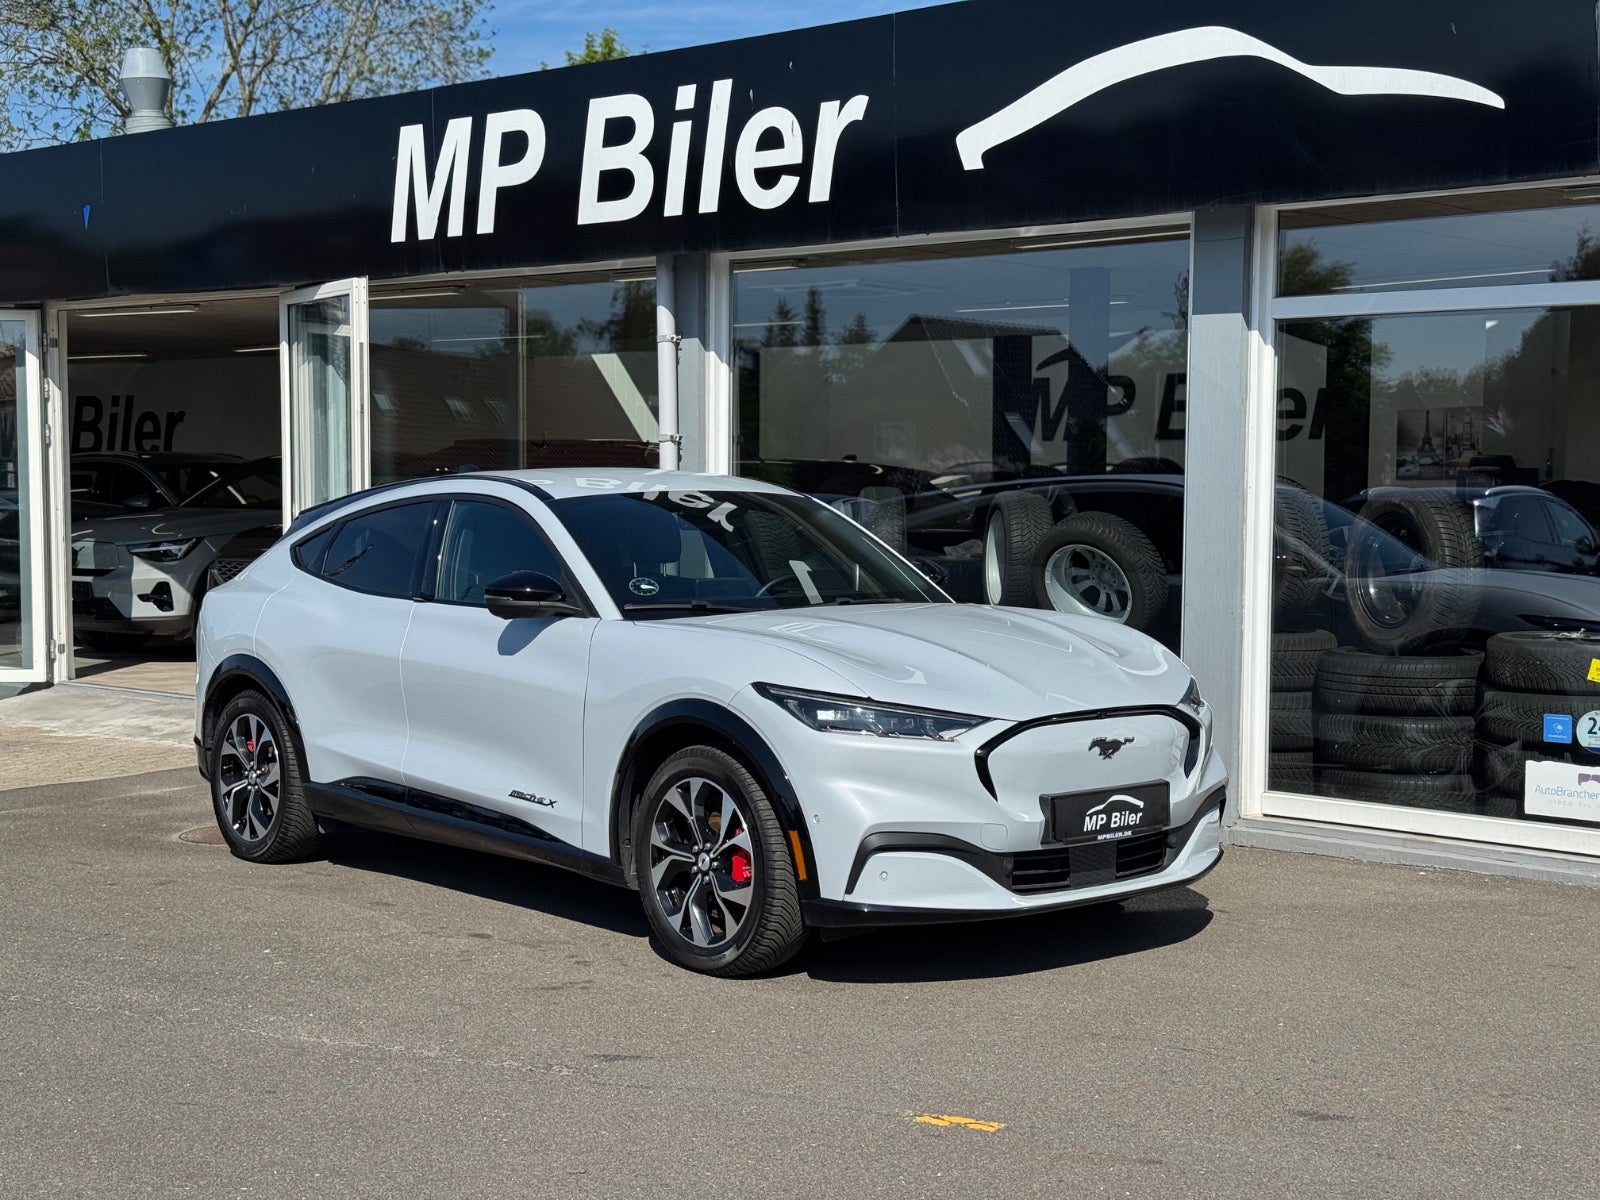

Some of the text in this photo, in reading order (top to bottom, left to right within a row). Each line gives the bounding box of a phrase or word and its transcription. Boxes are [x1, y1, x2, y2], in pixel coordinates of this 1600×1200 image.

[391, 78, 869, 243] MP Biler
[71, 394, 186, 452] Biler
[1587, 717, 1600, 735] 2
[1083, 810, 1143, 832] MP Biler
